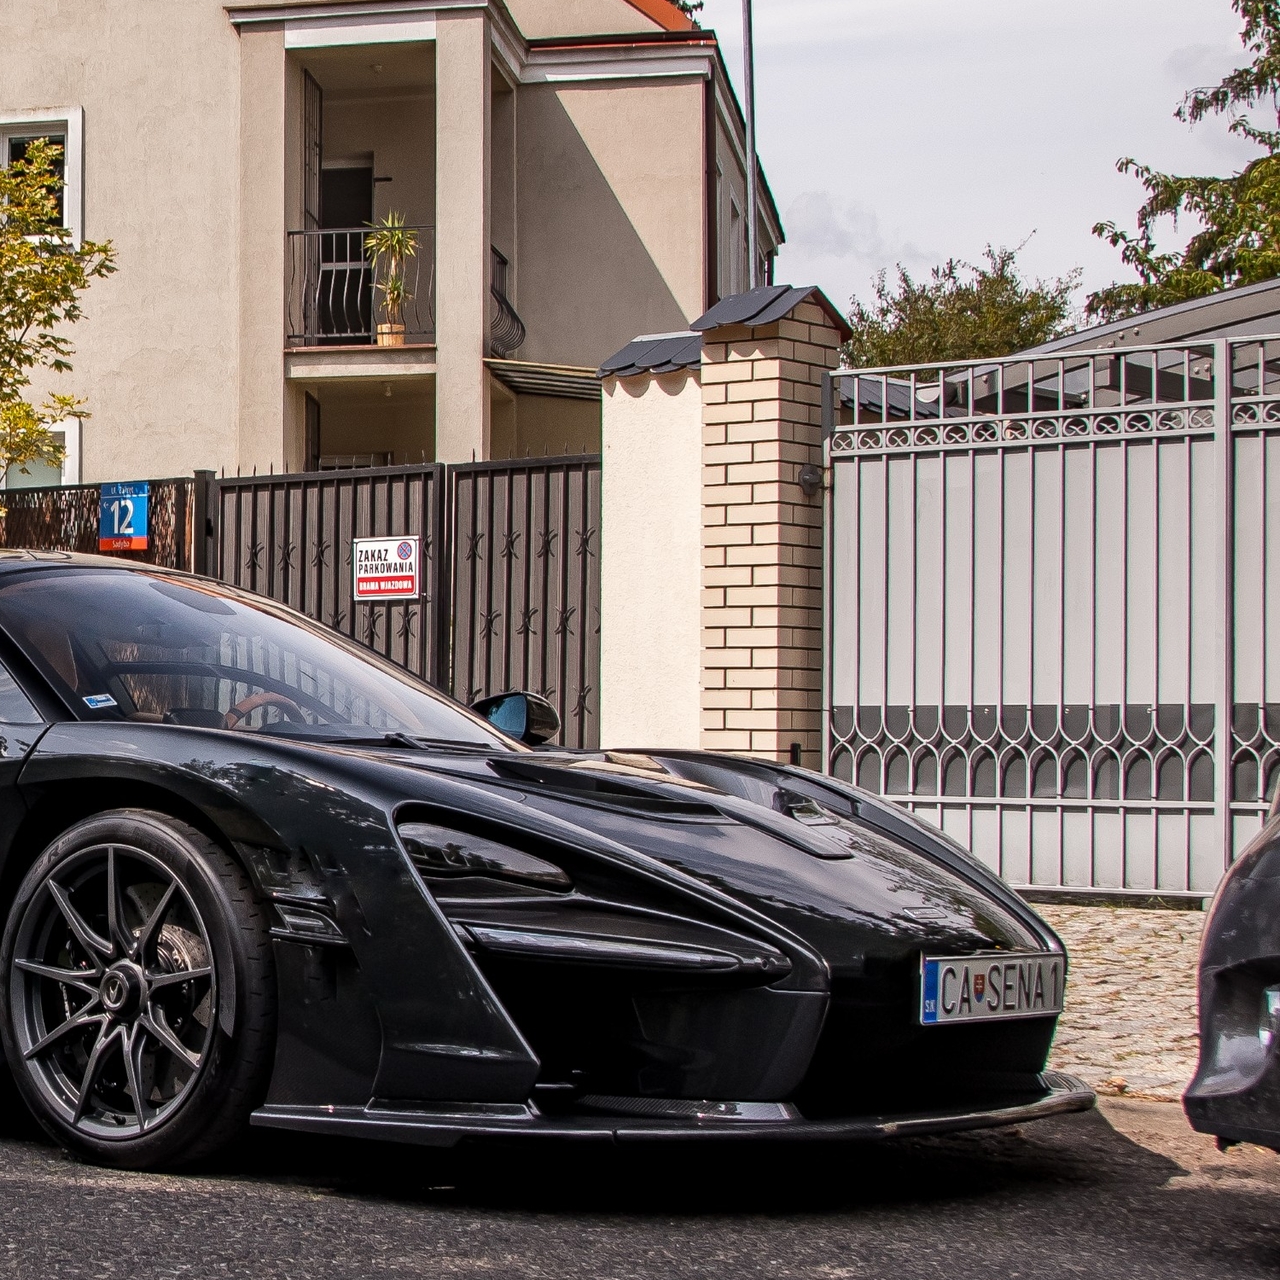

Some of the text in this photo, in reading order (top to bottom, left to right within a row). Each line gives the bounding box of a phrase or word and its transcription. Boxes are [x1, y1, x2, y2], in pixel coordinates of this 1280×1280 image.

[111, 499, 133, 534] 12
[358, 549, 389, 563] ZAKAZ
[358, 561, 414, 575] PARKOWANIA
[359, 580, 413, 591] BRAMA WJAZDOWA
[940, 965, 972, 1015] CA
